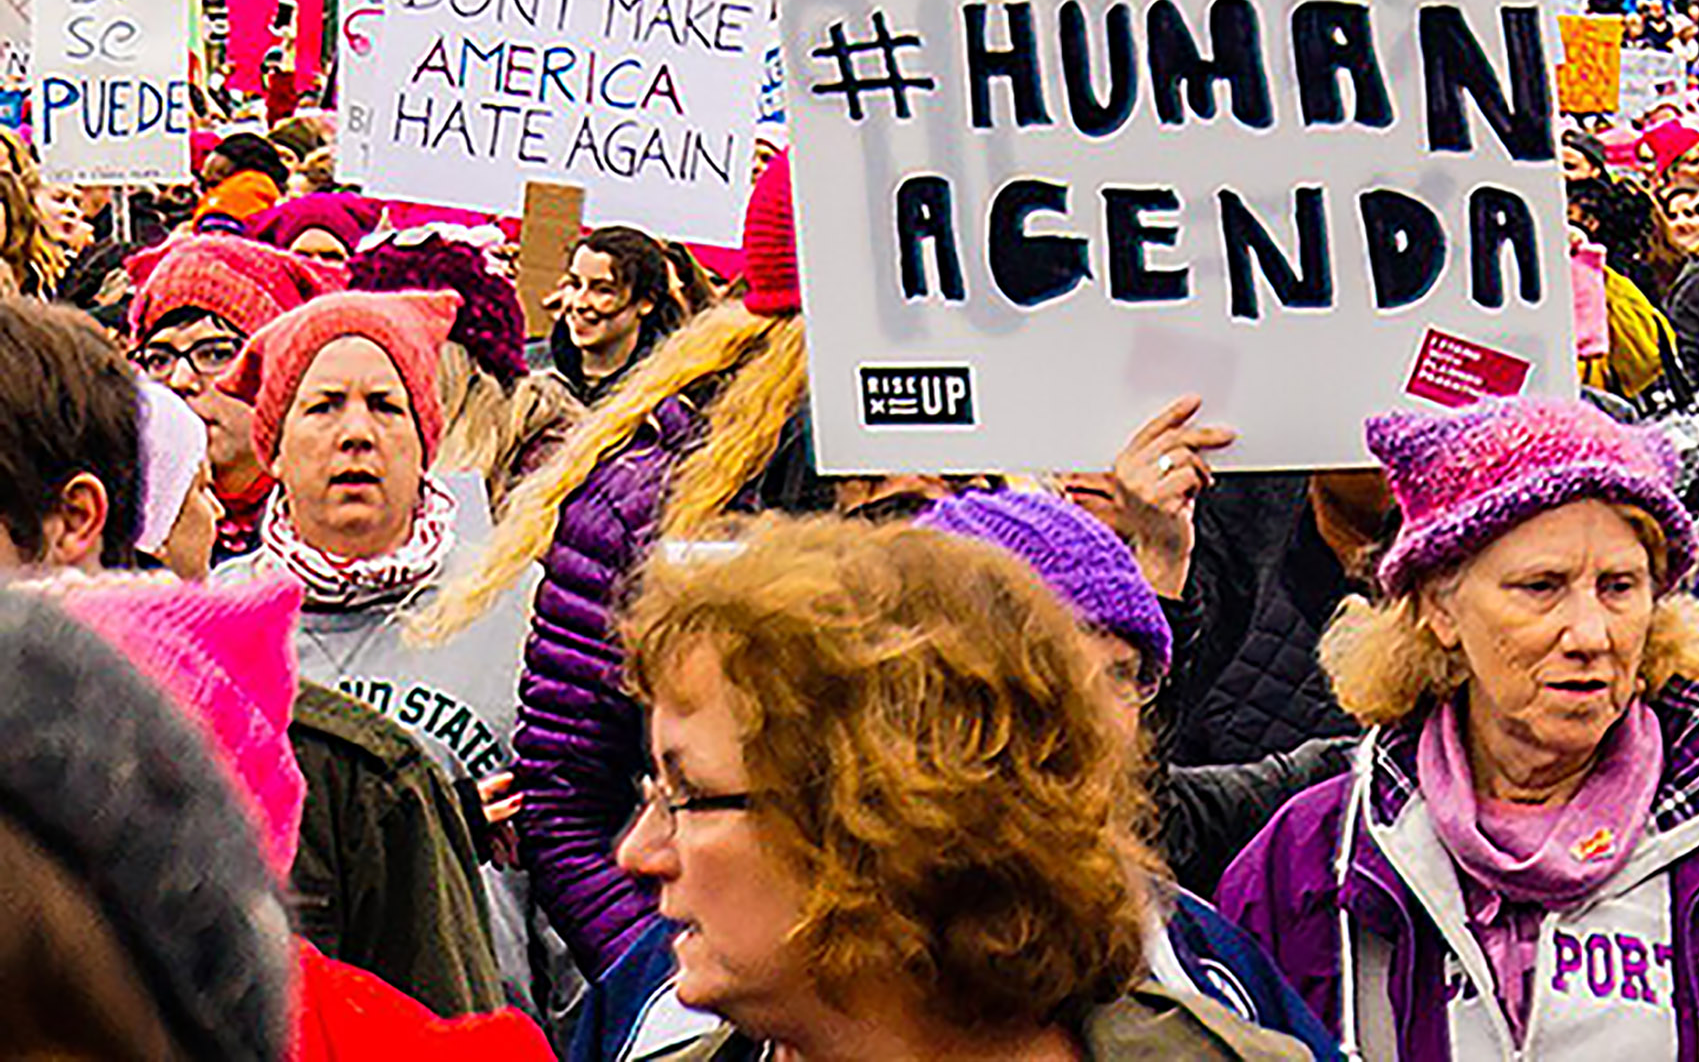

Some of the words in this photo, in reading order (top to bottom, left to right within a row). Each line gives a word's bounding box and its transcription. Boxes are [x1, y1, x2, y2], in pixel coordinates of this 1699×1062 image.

[43, 77, 187, 145] PUEDE
[412, 36, 685, 116] AMERICA
[393, 92, 553, 164] HATE
[565, 115, 735, 185] AGAIN
[895, 174, 1543, 322] AGENDA
[867, 376, 918, 395] RISE
[920, 375, 967, 416] UP
[398, 685, 503, 780] STATE
